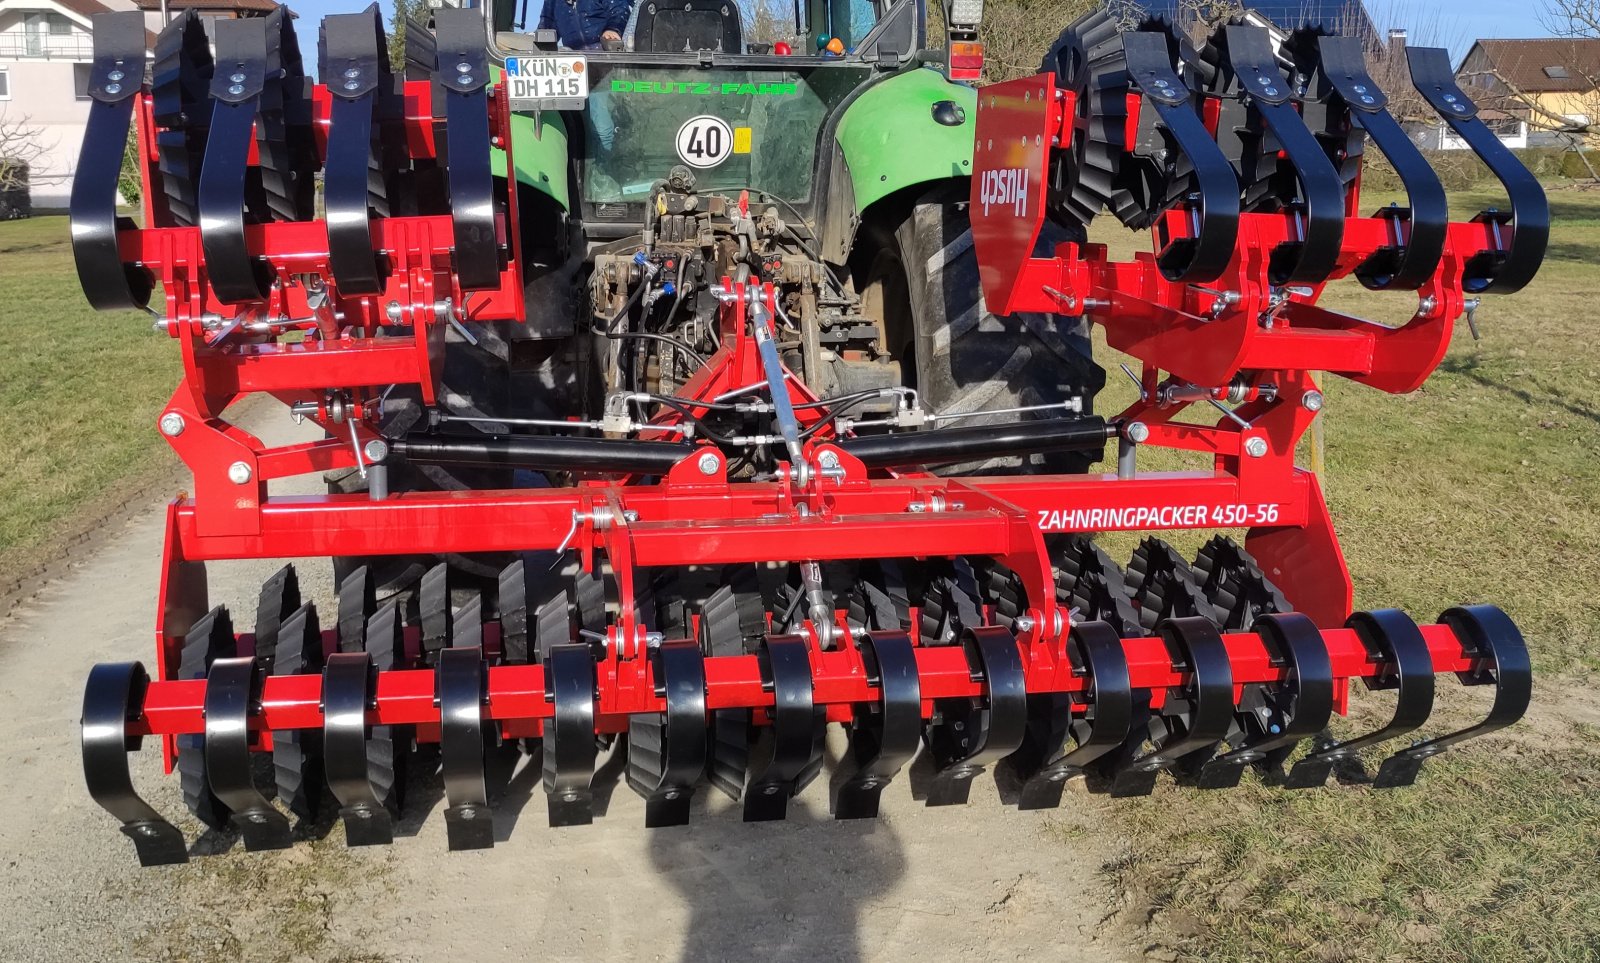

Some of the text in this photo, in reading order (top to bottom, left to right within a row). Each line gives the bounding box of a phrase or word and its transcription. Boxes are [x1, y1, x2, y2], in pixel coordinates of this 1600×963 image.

[520, 58, 557, 77] KÜN
[514, 78, 580, 97] DH 115
[687, 126, 720, 159] 40
[980, 168, 1029, 217] Husch
[1037, 504, 1279, 530] ZAHNRINGPACKER 450-56
